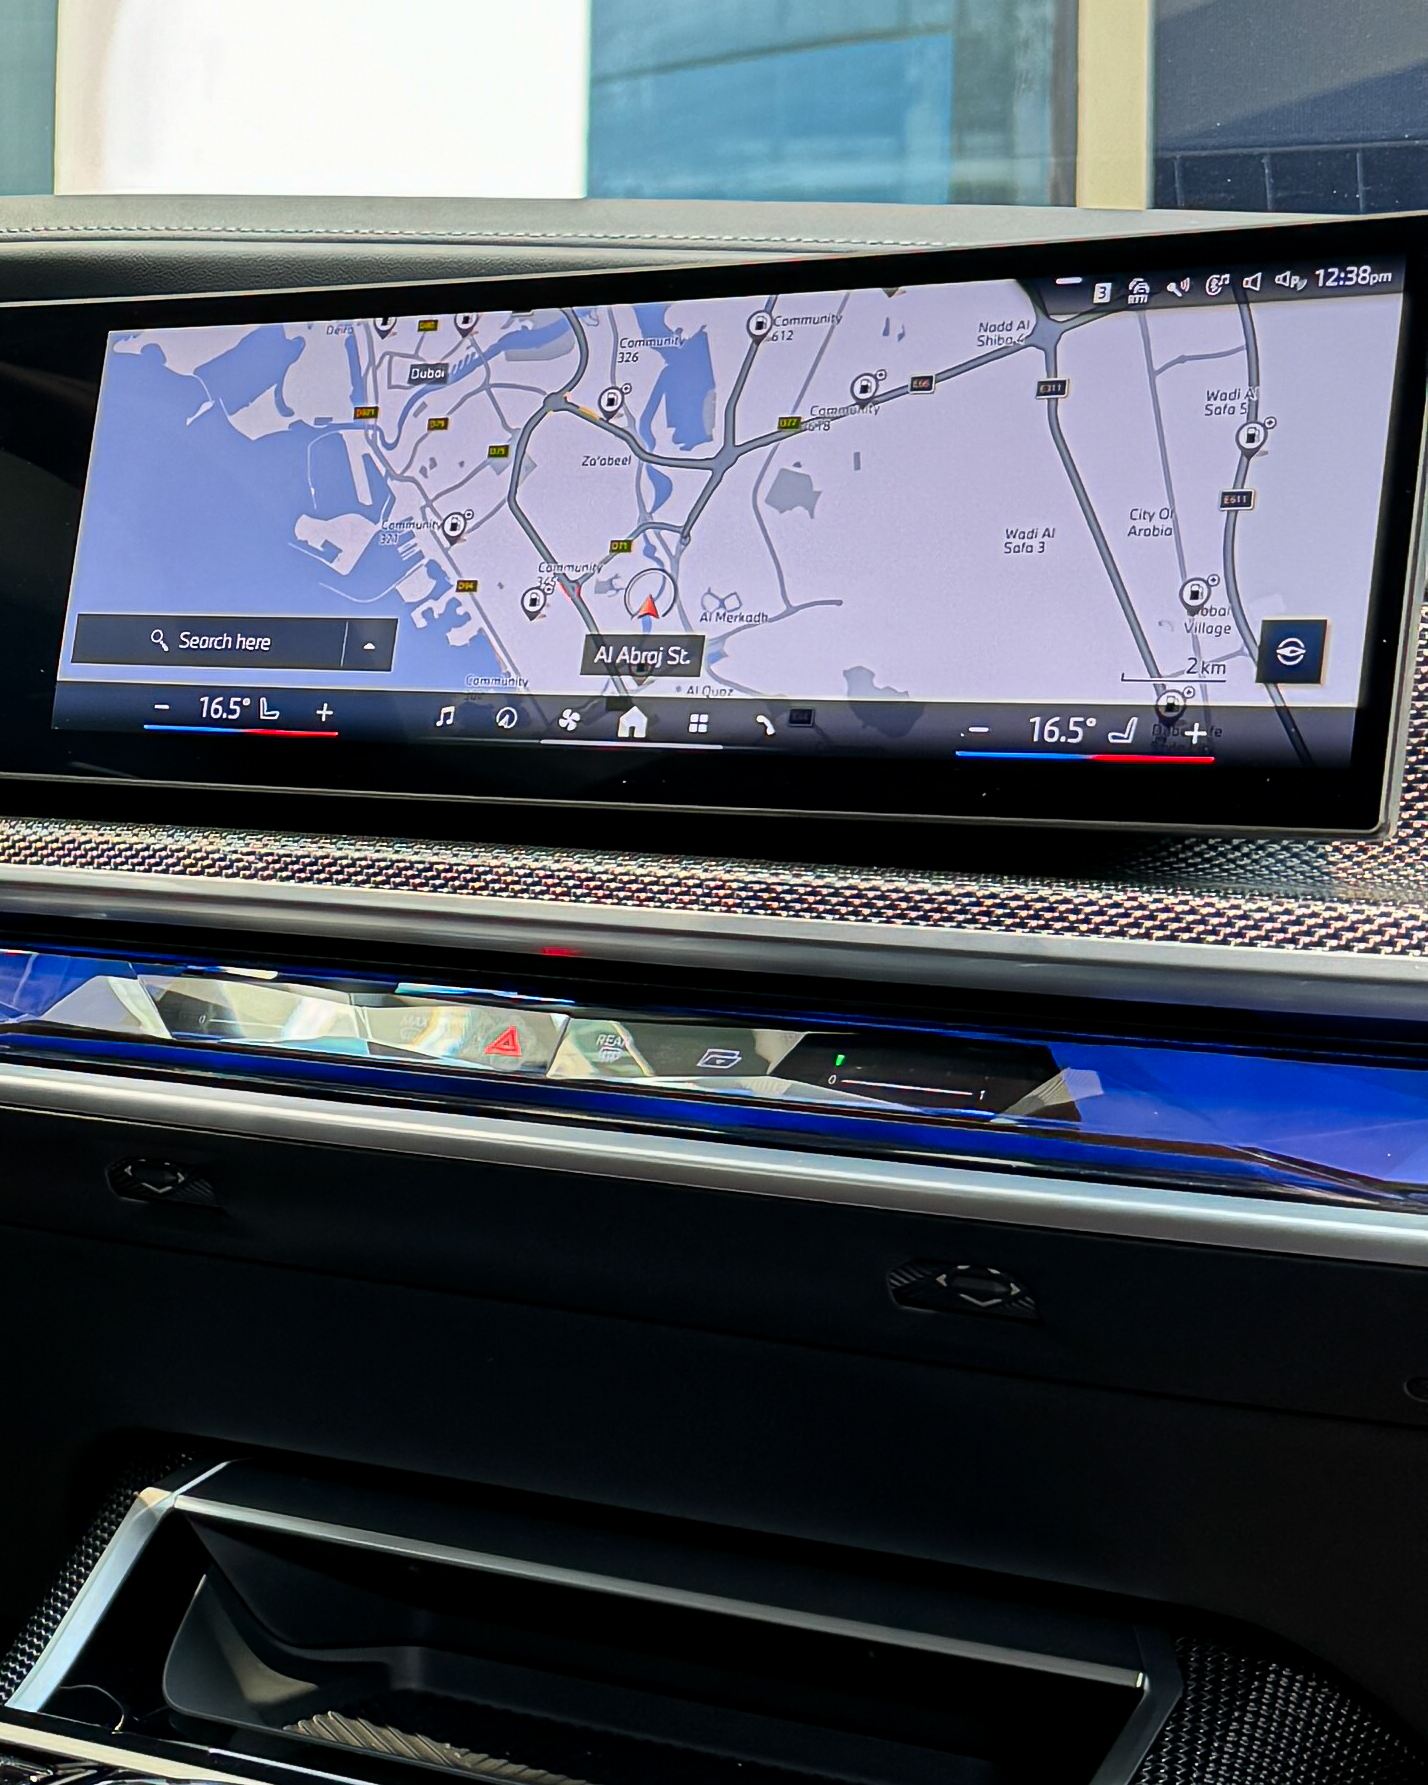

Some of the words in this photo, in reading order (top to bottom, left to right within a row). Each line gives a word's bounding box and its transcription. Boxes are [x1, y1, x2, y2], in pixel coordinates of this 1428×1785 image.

[773, 313, 843, 327] Community
[978, 321, 1013, 333] Nadd
[1016, 319, 1030, 331] Al
[619, 336, 686, 349] Community
[771, 330, 794, 342] 612
[976, 334, 1013, 347] Shiba
[617, 352, 639, 364] 326
[1206, 388, 1241, 402] Wadi
[810, 404, 881, 417] Community
[1204, 403, 1236, 416] Safa
[1129, 509, 1155, 523] City
[381, 520, 442, 532] Community
[1127, 526, 1173, 538] Arabia
[1005, 528, 1038, 540] Wadi
[1042, 527, 1056, 539] Al
[1004, 542, 1033, 554] Safa
[1037, 541, 1046, 554] 3
[538, 562, 603, 575] Community
[699, 612, 713, 623] Al
[715, 612, 769, 624] Merkadh
[1184, 622, 1232, 638] Village
[178, 631, 232, 651] Search
[235, 632, 271, 652] here
[594, 646, 614, 664] Al
[616, 646, 663, 668] Abraj
[667, 647, 691, 665] St.
[1186, 658, 1198, 675] 2
[1201, 661, 1226, 675] km
[466, 674, 529, 689] Community
[686, 686, 700, 696] Al
